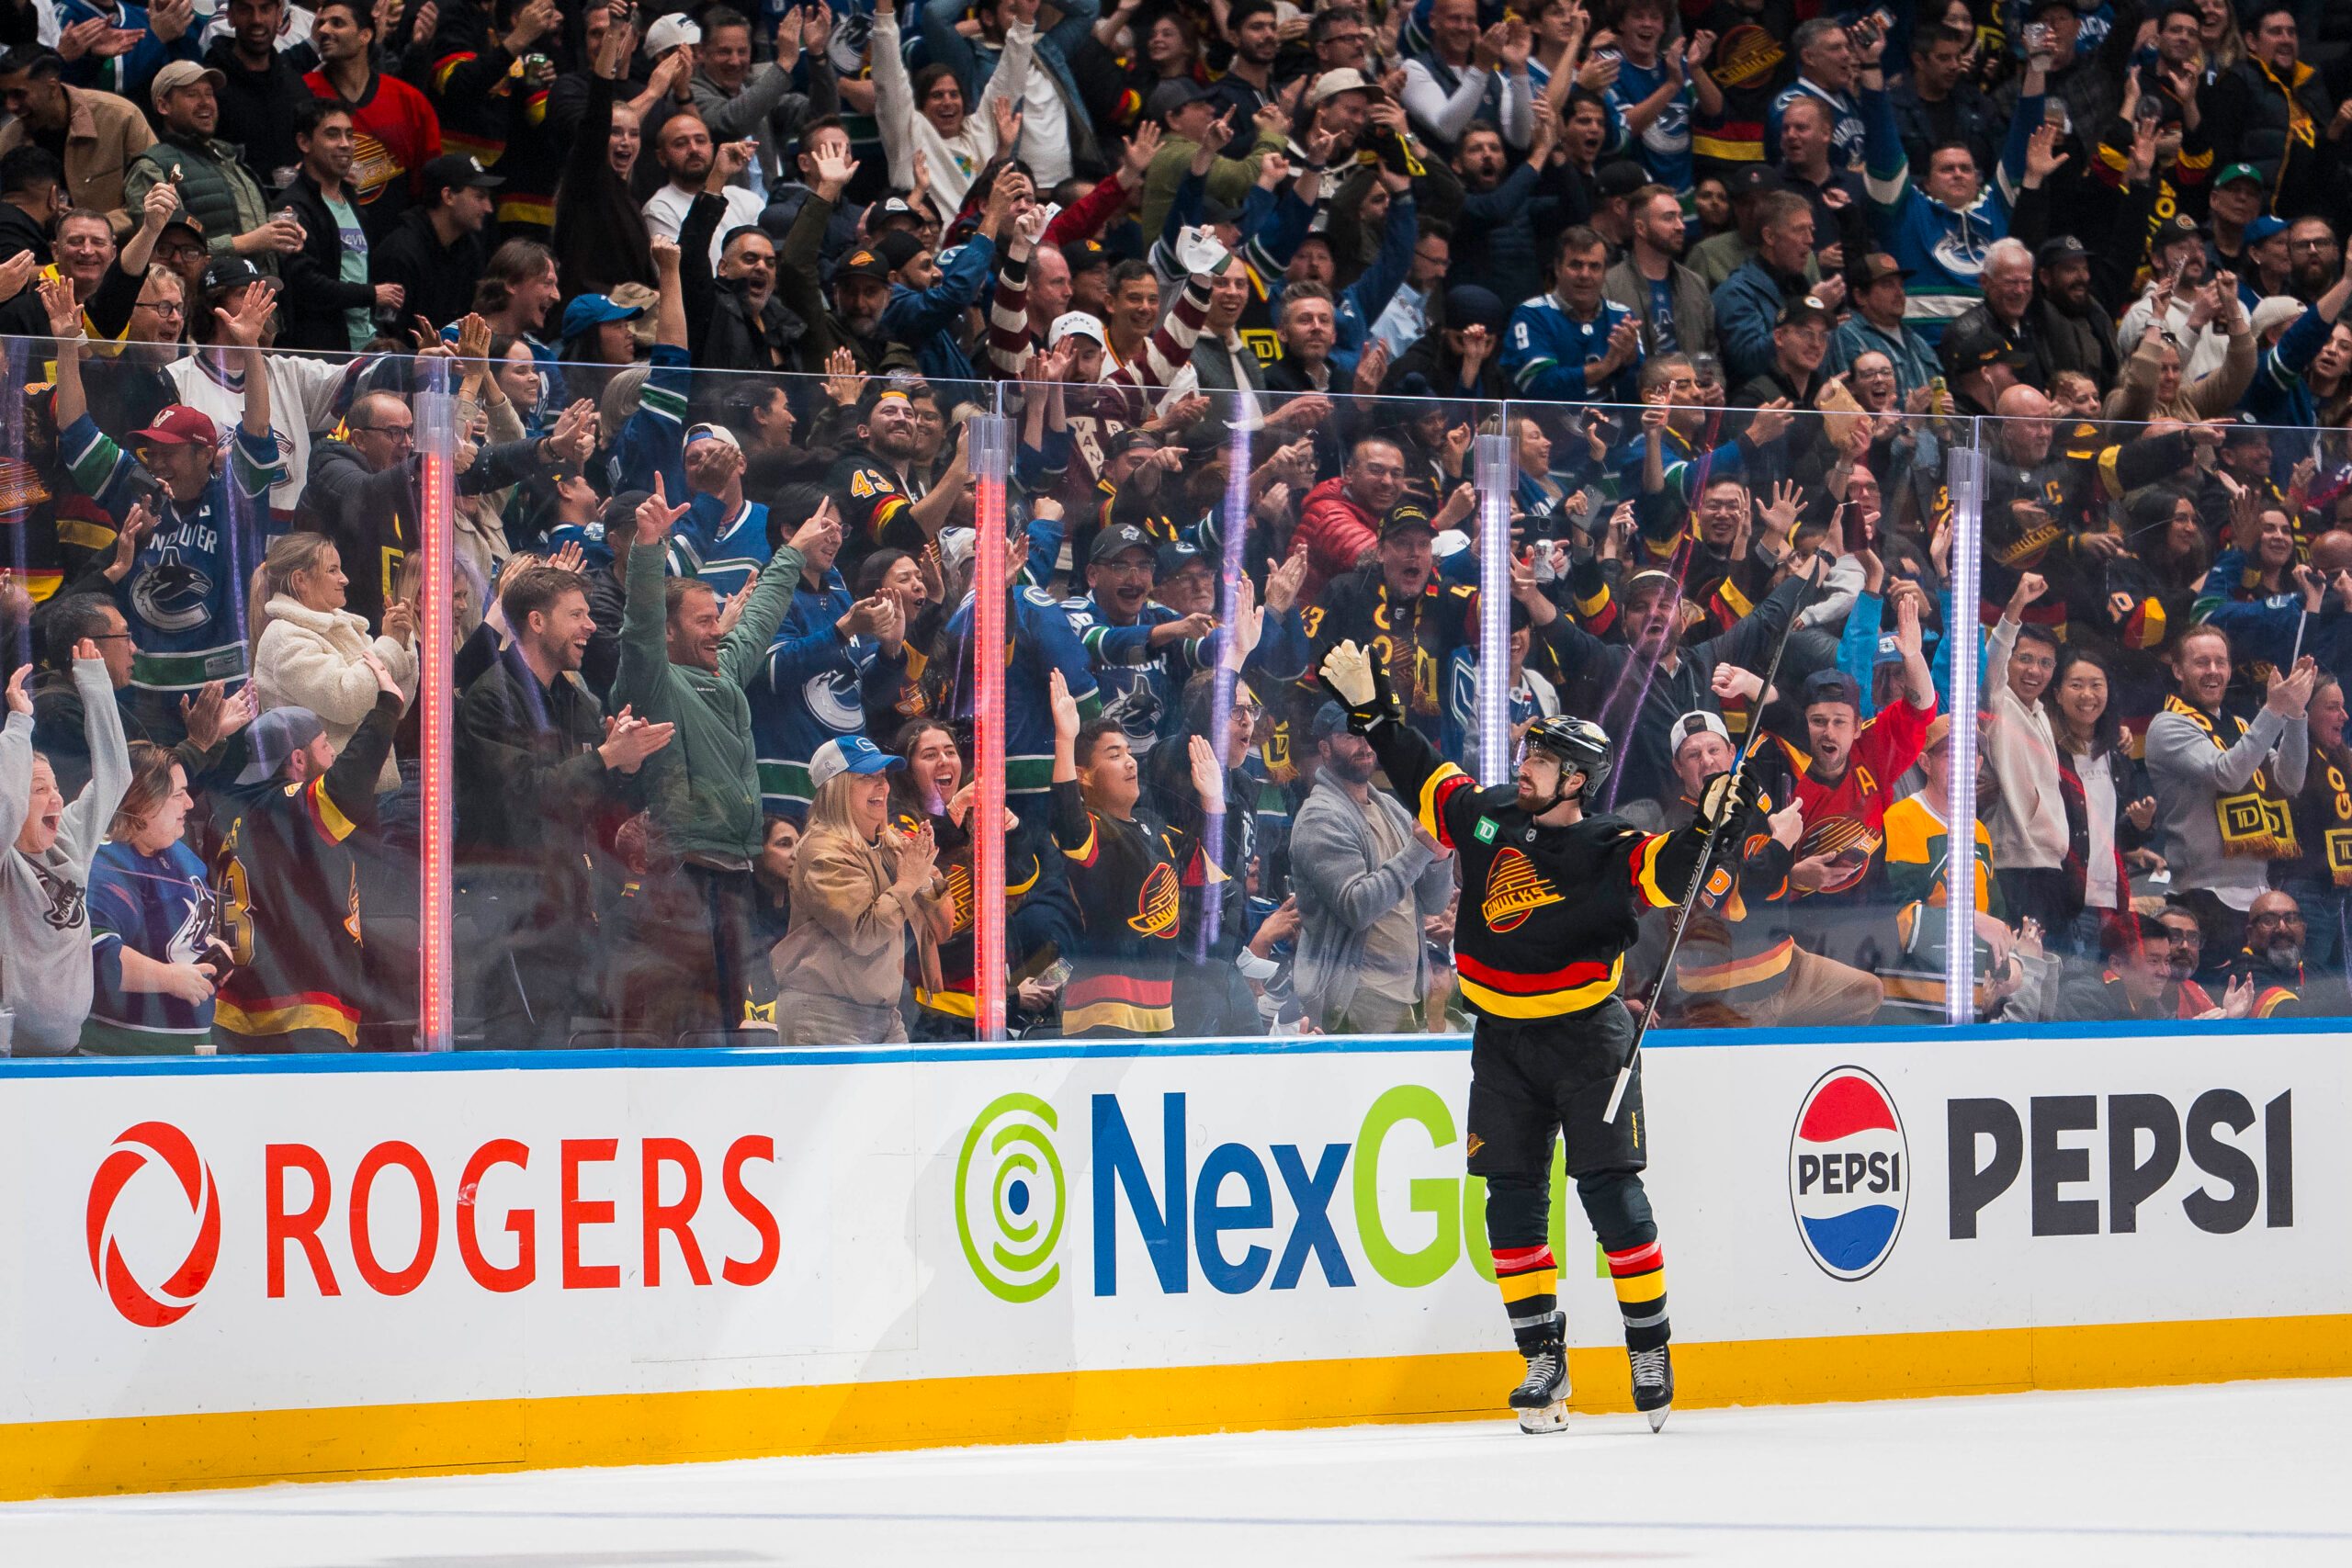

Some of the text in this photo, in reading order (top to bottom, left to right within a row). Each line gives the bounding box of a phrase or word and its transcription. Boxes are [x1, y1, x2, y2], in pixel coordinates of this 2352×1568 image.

[1250, 341, 1274, 360] TD
[1513, 321, 1531, 351] 9
[851, 468, 895, 500] 43
[1855, 765, 1878, 795] A
[1479, 819, 1496, 840] TD
[2230, 809, 2259, 829] TD
[1798, 1151, 1900, 1195] PEPSI
[1948, 1088, 2294, 1240] PEPSI
[1091, 1083, 1611, 1298] NexG
[266, 1134, 781, 1299] ROGERS
